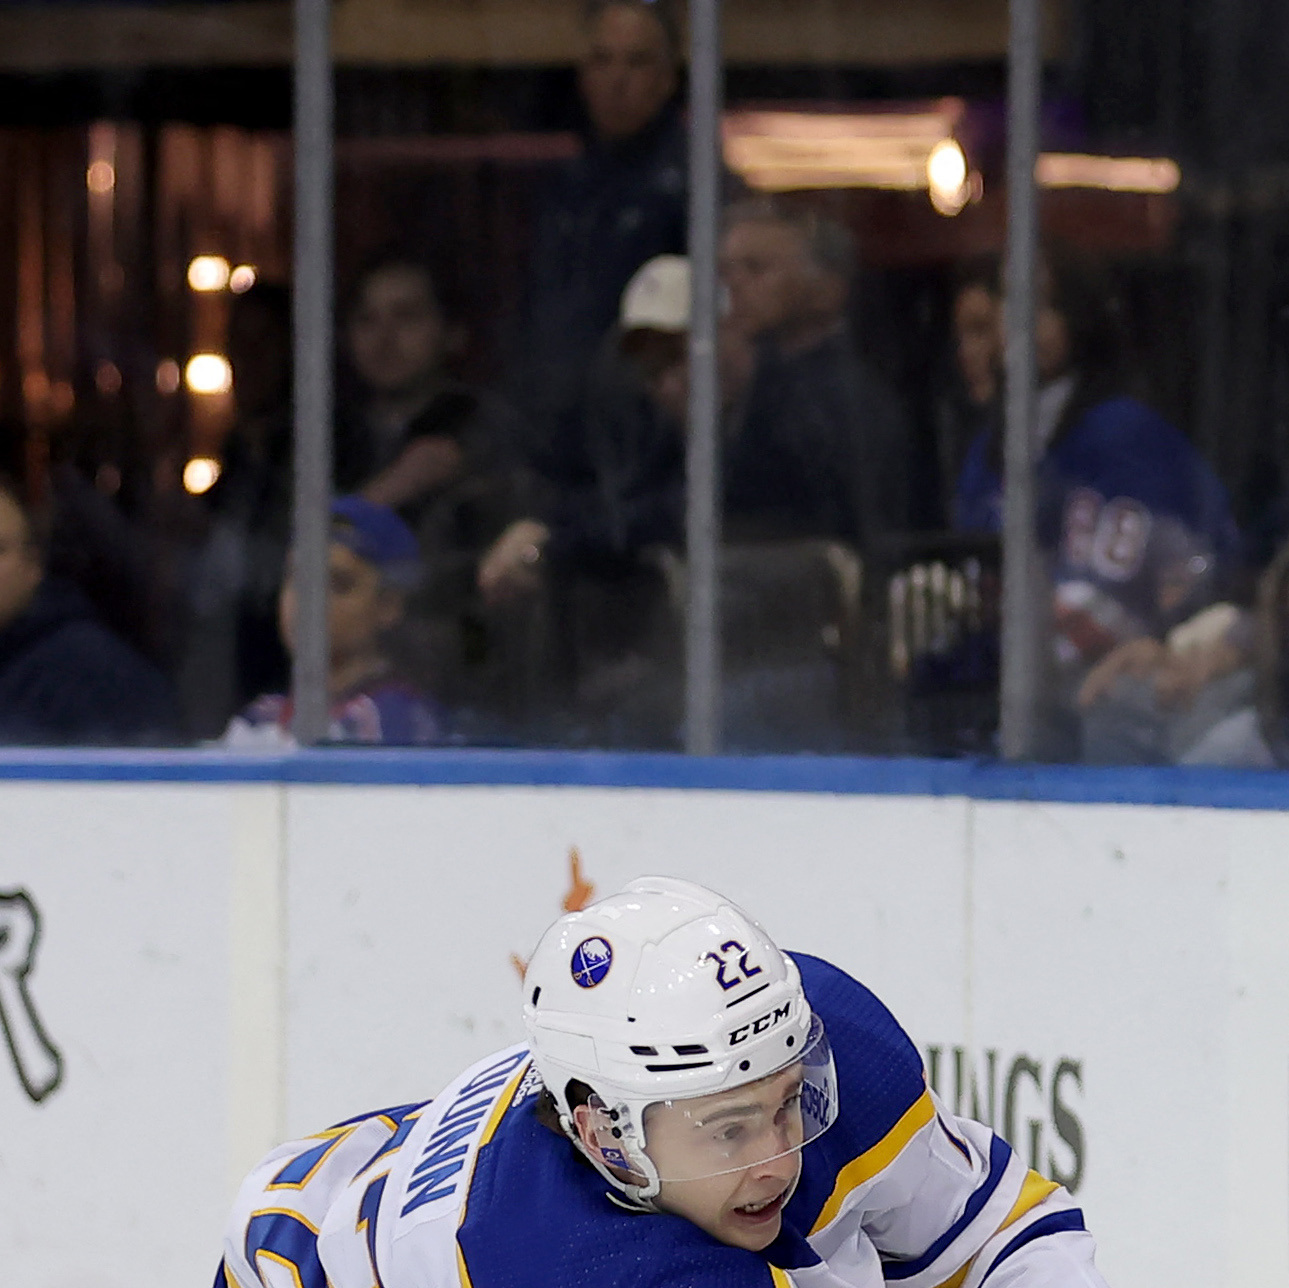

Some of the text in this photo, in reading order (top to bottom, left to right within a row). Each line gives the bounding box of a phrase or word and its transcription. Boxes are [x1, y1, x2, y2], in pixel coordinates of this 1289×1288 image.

[698, 940, 763, 992] 22
[728, 1001, 791, 1046] CCM
[400, 1049, 531, 1218] QUINN
